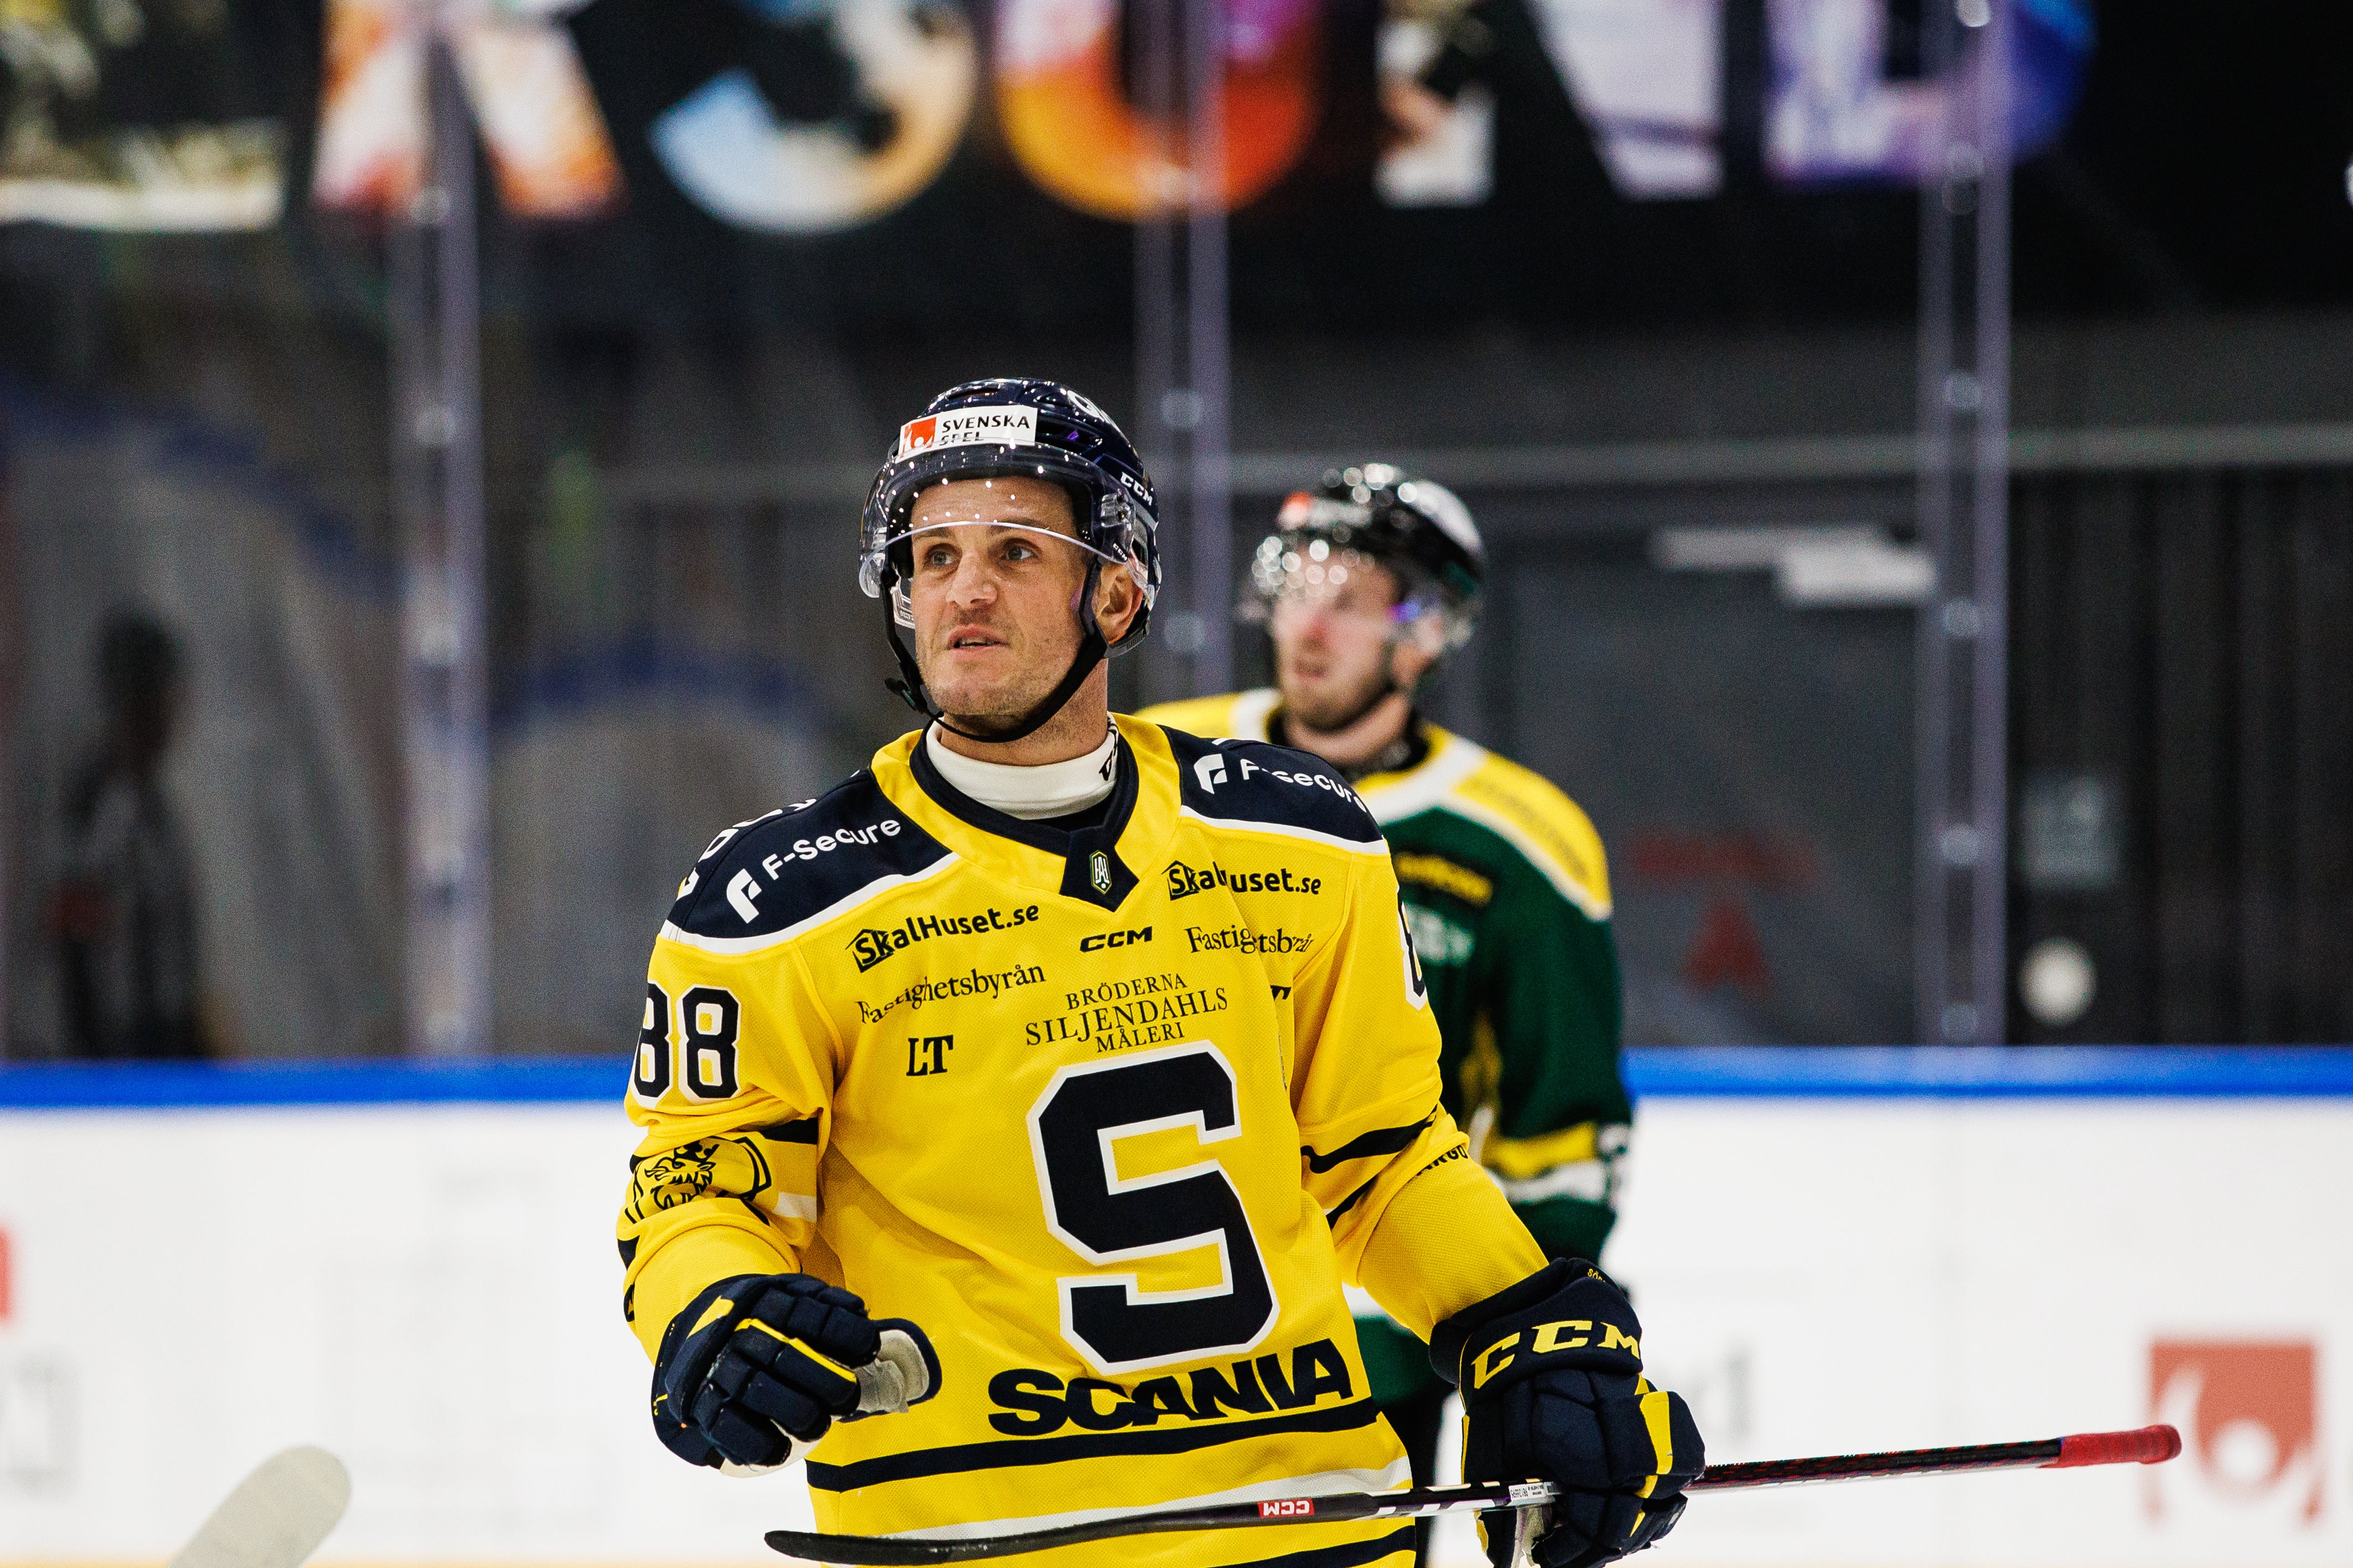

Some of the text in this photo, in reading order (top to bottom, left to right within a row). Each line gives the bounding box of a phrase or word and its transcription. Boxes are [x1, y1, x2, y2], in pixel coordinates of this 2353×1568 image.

[942, 415, 1031, 433] SVENSKA
[1120, 471, 1154, 506] CCM
[762, 819, 901, 881] F-Secure
[853, 904, 1039, 966] SkalHuset.se
[1080, 926, 1153, 953] CCM
[1065, 973, 1187, 1010] BRÖDERNA
[1026, 987, 1228, 1046] SILJENDAHLS
[1096, 1021, 1185, 1053] MÅLERI
[906, 1035, 954, 1077] LT
[1027, 1040, 1280, 1376] S
[1471, 1320, 1641, 1389] CCM
[988, 1338, 1354, 1437] SCANIA
[1263, 1500, 1310, 1516] CCM
